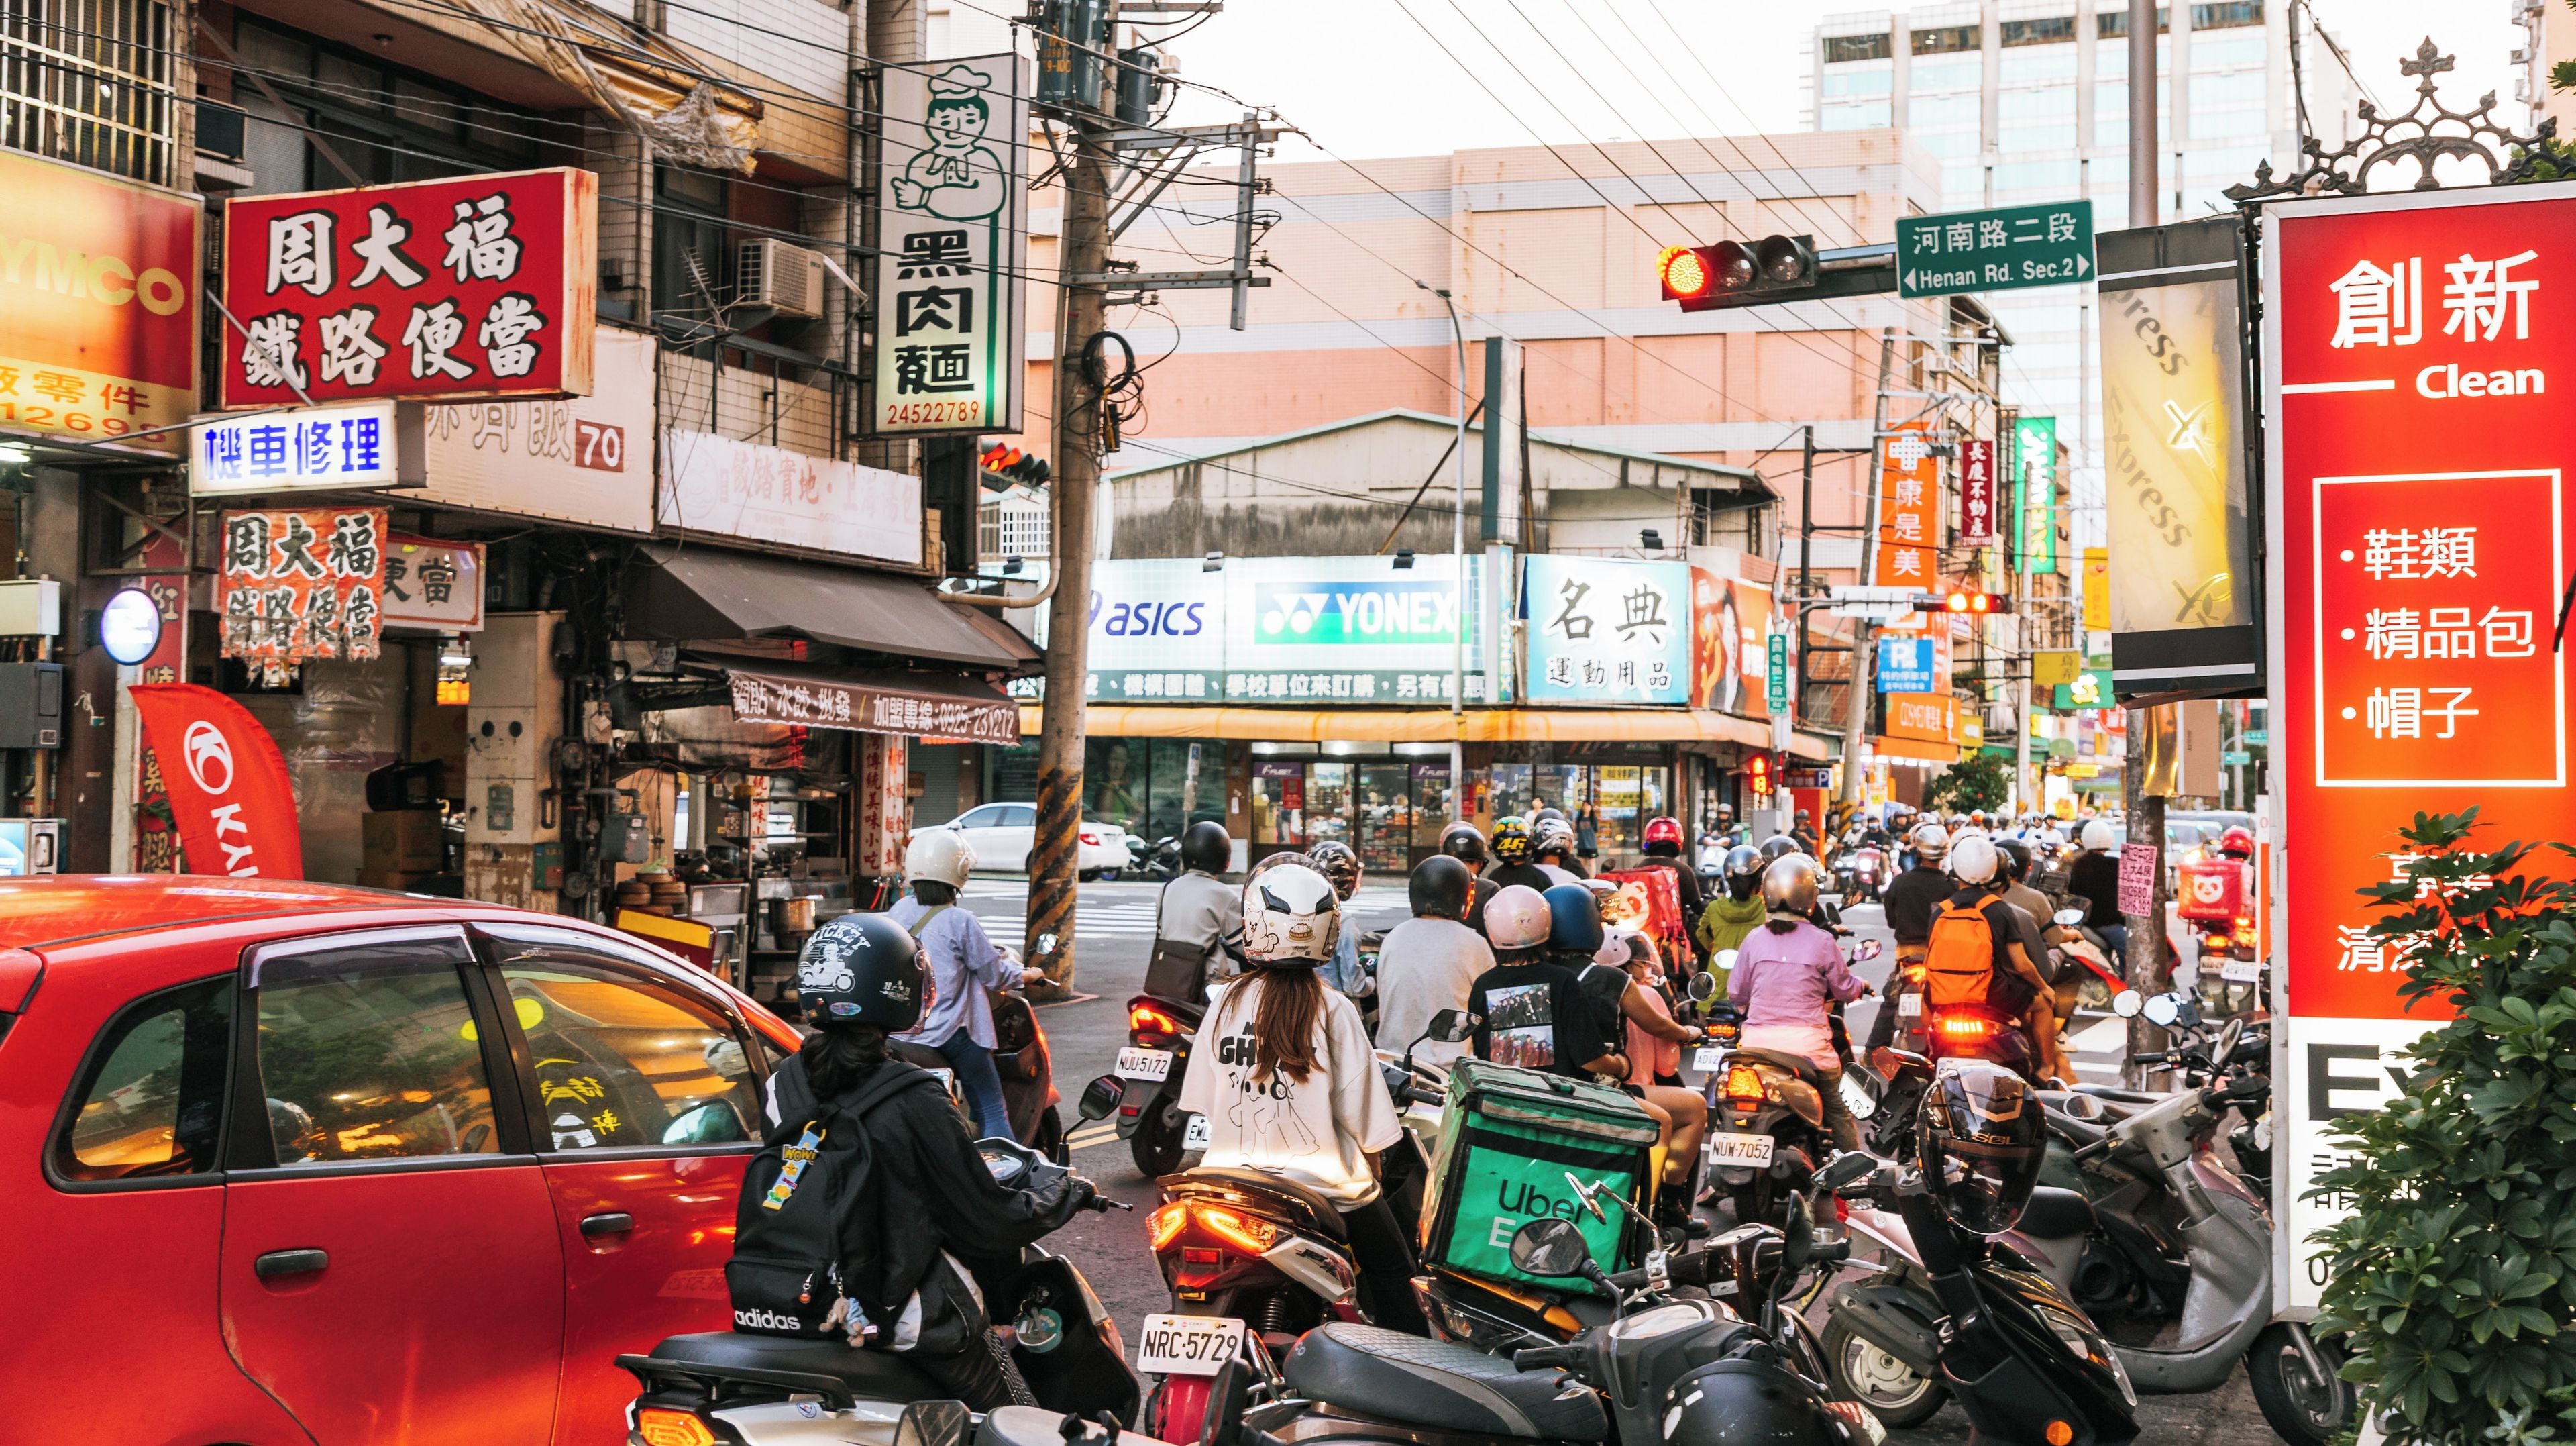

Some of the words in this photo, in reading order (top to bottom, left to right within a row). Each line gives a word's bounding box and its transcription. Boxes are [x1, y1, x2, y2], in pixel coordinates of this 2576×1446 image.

[266, 195, 519, 296] 周大福
[1913, 213, 2076, 254] 河南路二段
[1920, 270, 1976, 289] Henan
[1985, 263, 2014, 283] Rd.
[2023, 258, 2073, 280] Sec.2
[894, 229, 975, 395] 黑肉麵
[2329, 250, 2539, 348] 創新
[241, 297, 544, 392] 鐵路便當
[2416, 364, 2544, 399] Clean
[888, 401, 979, 425] 24522789
[204, 415, 380, 481] 機車修理
[580, 424, 621, 468] 70
[225, 513, 378, 579] 周大福
[1893, 478, 1923, 576] 康是美
[2364, 527, 2477, 580] 鞋類
[1106, 602, 1205, 637] asics
[1336, 592, 1457, 634] YONEX
[1550, 577, 1668, 645] 名典
[2365, 605, 2536, 660] 精品包
[1549, 658, 1669, 687] 運動用品
[2367, 687, 2479, 739] 帽子
[1819, 771, 1829, 786] P
[1497, 838, 1527, 849] 46
[1118, 1055, 1168, 1074] NUU-5172
[735, 1309, 801, 1331] adidas
